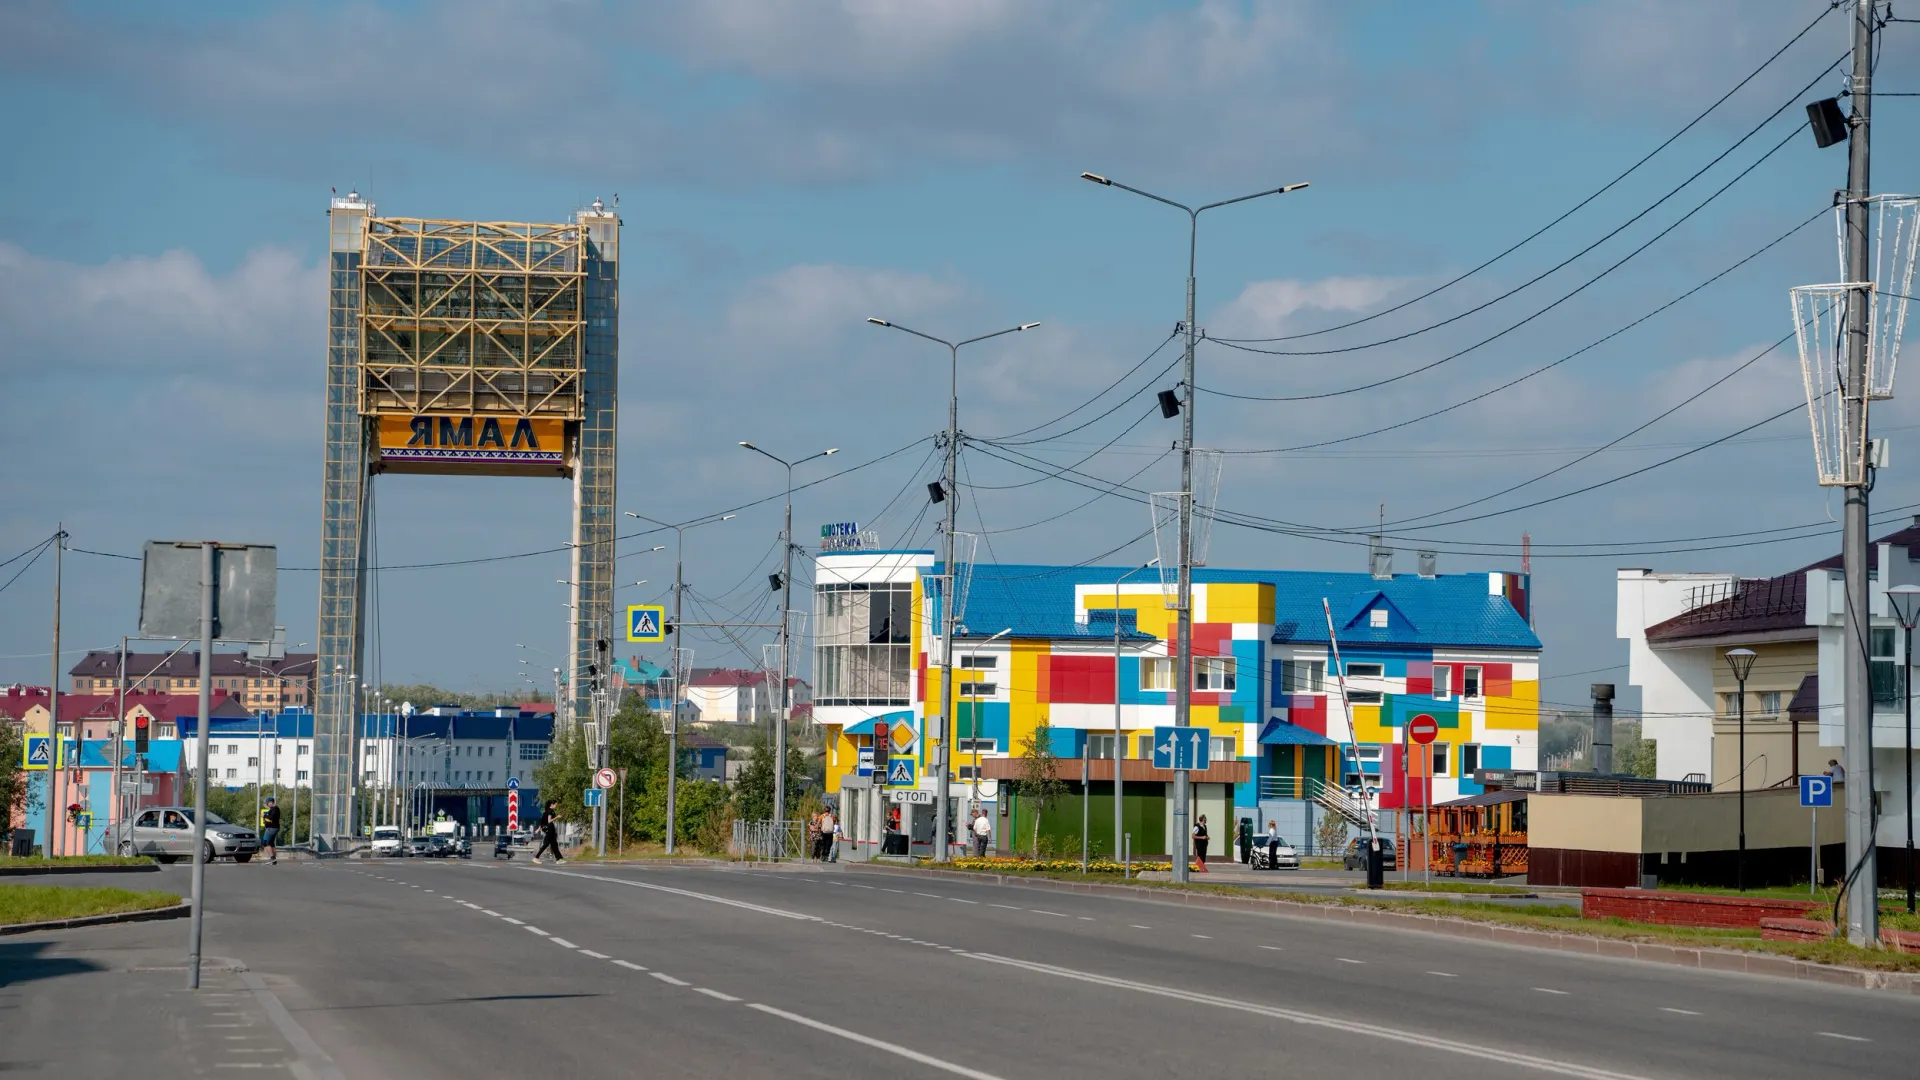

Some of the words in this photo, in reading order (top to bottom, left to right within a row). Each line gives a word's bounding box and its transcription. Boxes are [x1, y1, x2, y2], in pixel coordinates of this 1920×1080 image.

[407, 416, 539, 448] ЯМАЛ
[896, 791, 927, 802] СТОП
[1808, 779, 1827, 804] P
